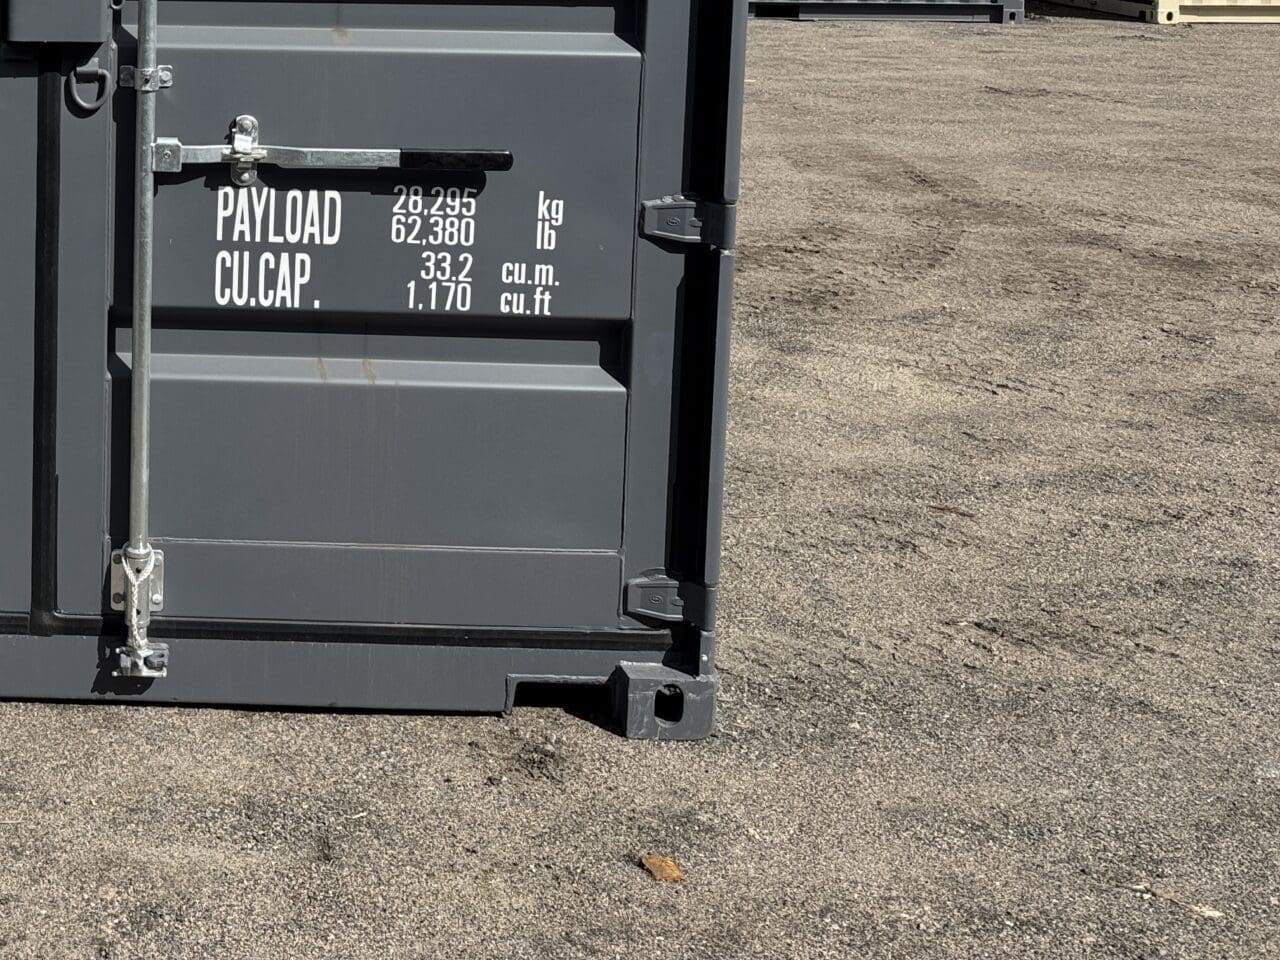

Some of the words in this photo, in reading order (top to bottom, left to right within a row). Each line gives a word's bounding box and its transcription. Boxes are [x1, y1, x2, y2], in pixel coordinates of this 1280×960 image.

[216, 186, 342, 245] PAYLOAD
[392, 185, 477, 217] 28,295
[537, 190, 564, 226] kg
[391, 215, 475, 247] 62,380
[536, 220, 556, 250] lb
[420, 251, 473, 282] 33.2
[501, 261, 560, 287] cu.m.
[406, 280, 472, 312] 1,170
[500, 286, 552, 316] cu.ft
